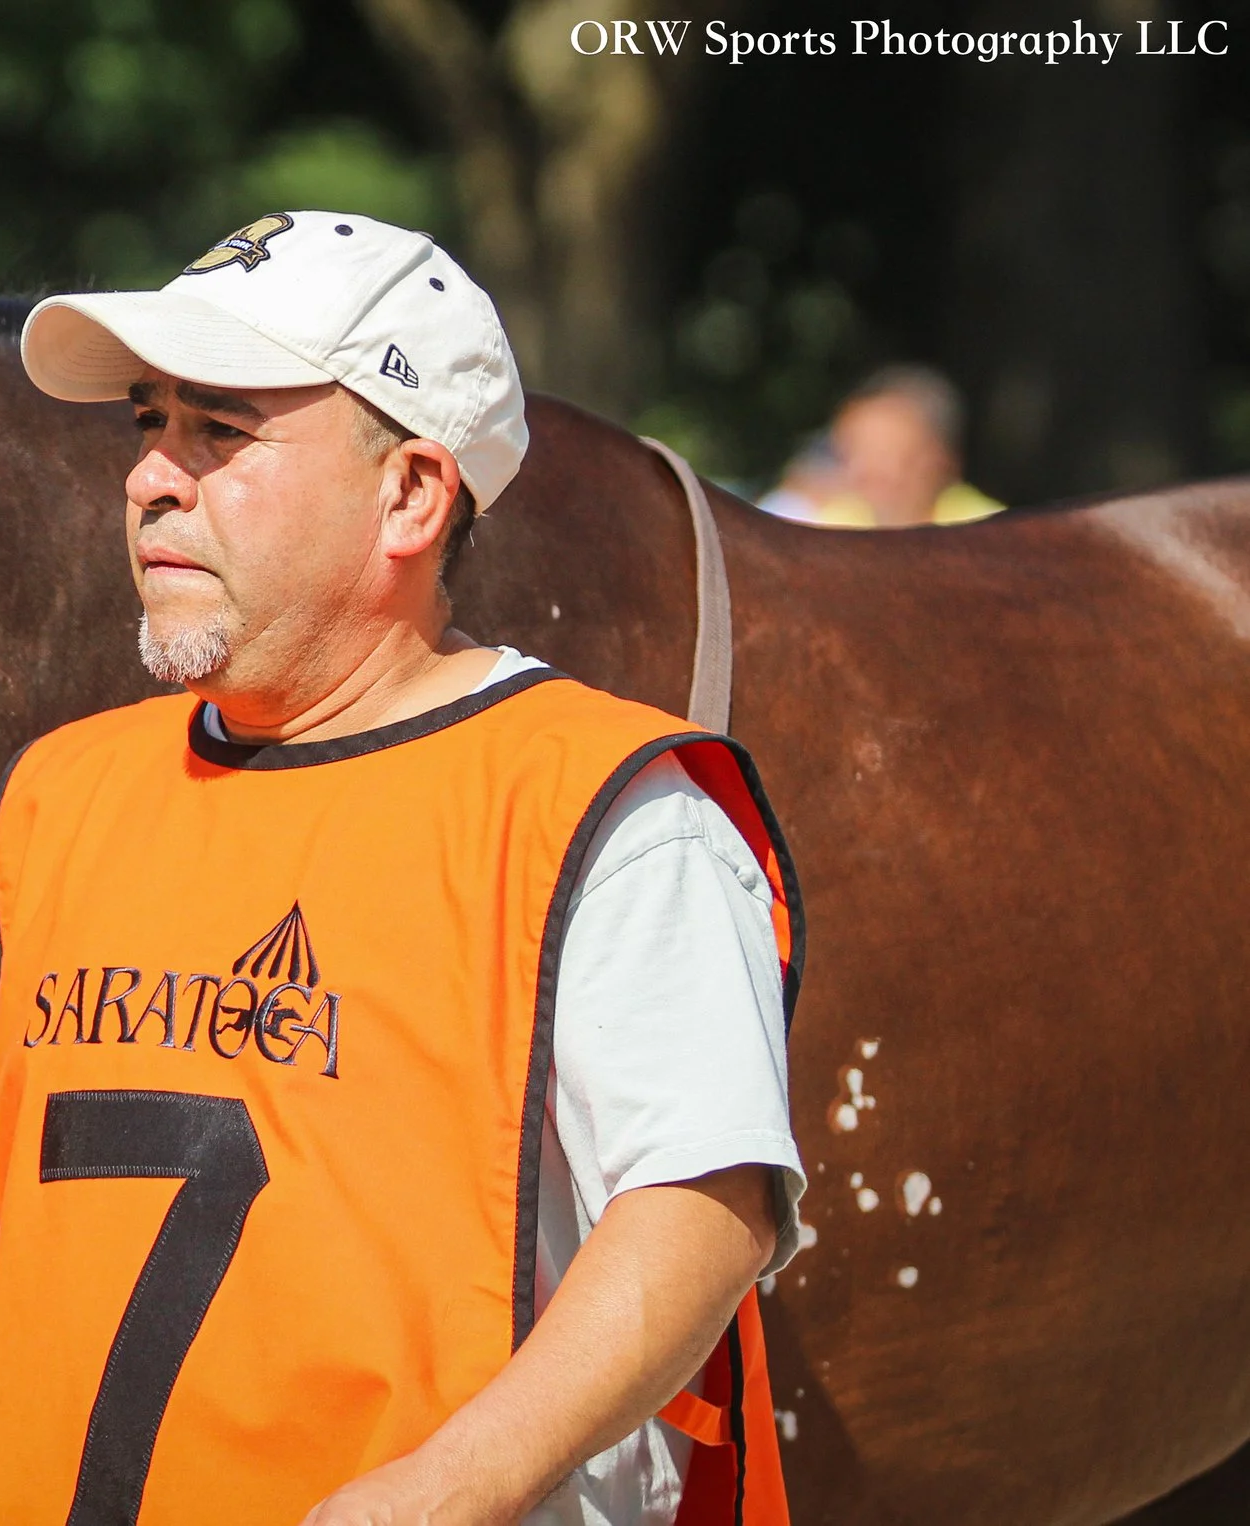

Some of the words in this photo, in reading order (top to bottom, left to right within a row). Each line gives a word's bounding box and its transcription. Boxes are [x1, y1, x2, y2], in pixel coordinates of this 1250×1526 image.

[229, 239, 253, 250] YORK
[23, 967, 342, 1079] SARATOGA
[40, 1090, 270, 1526] 7
